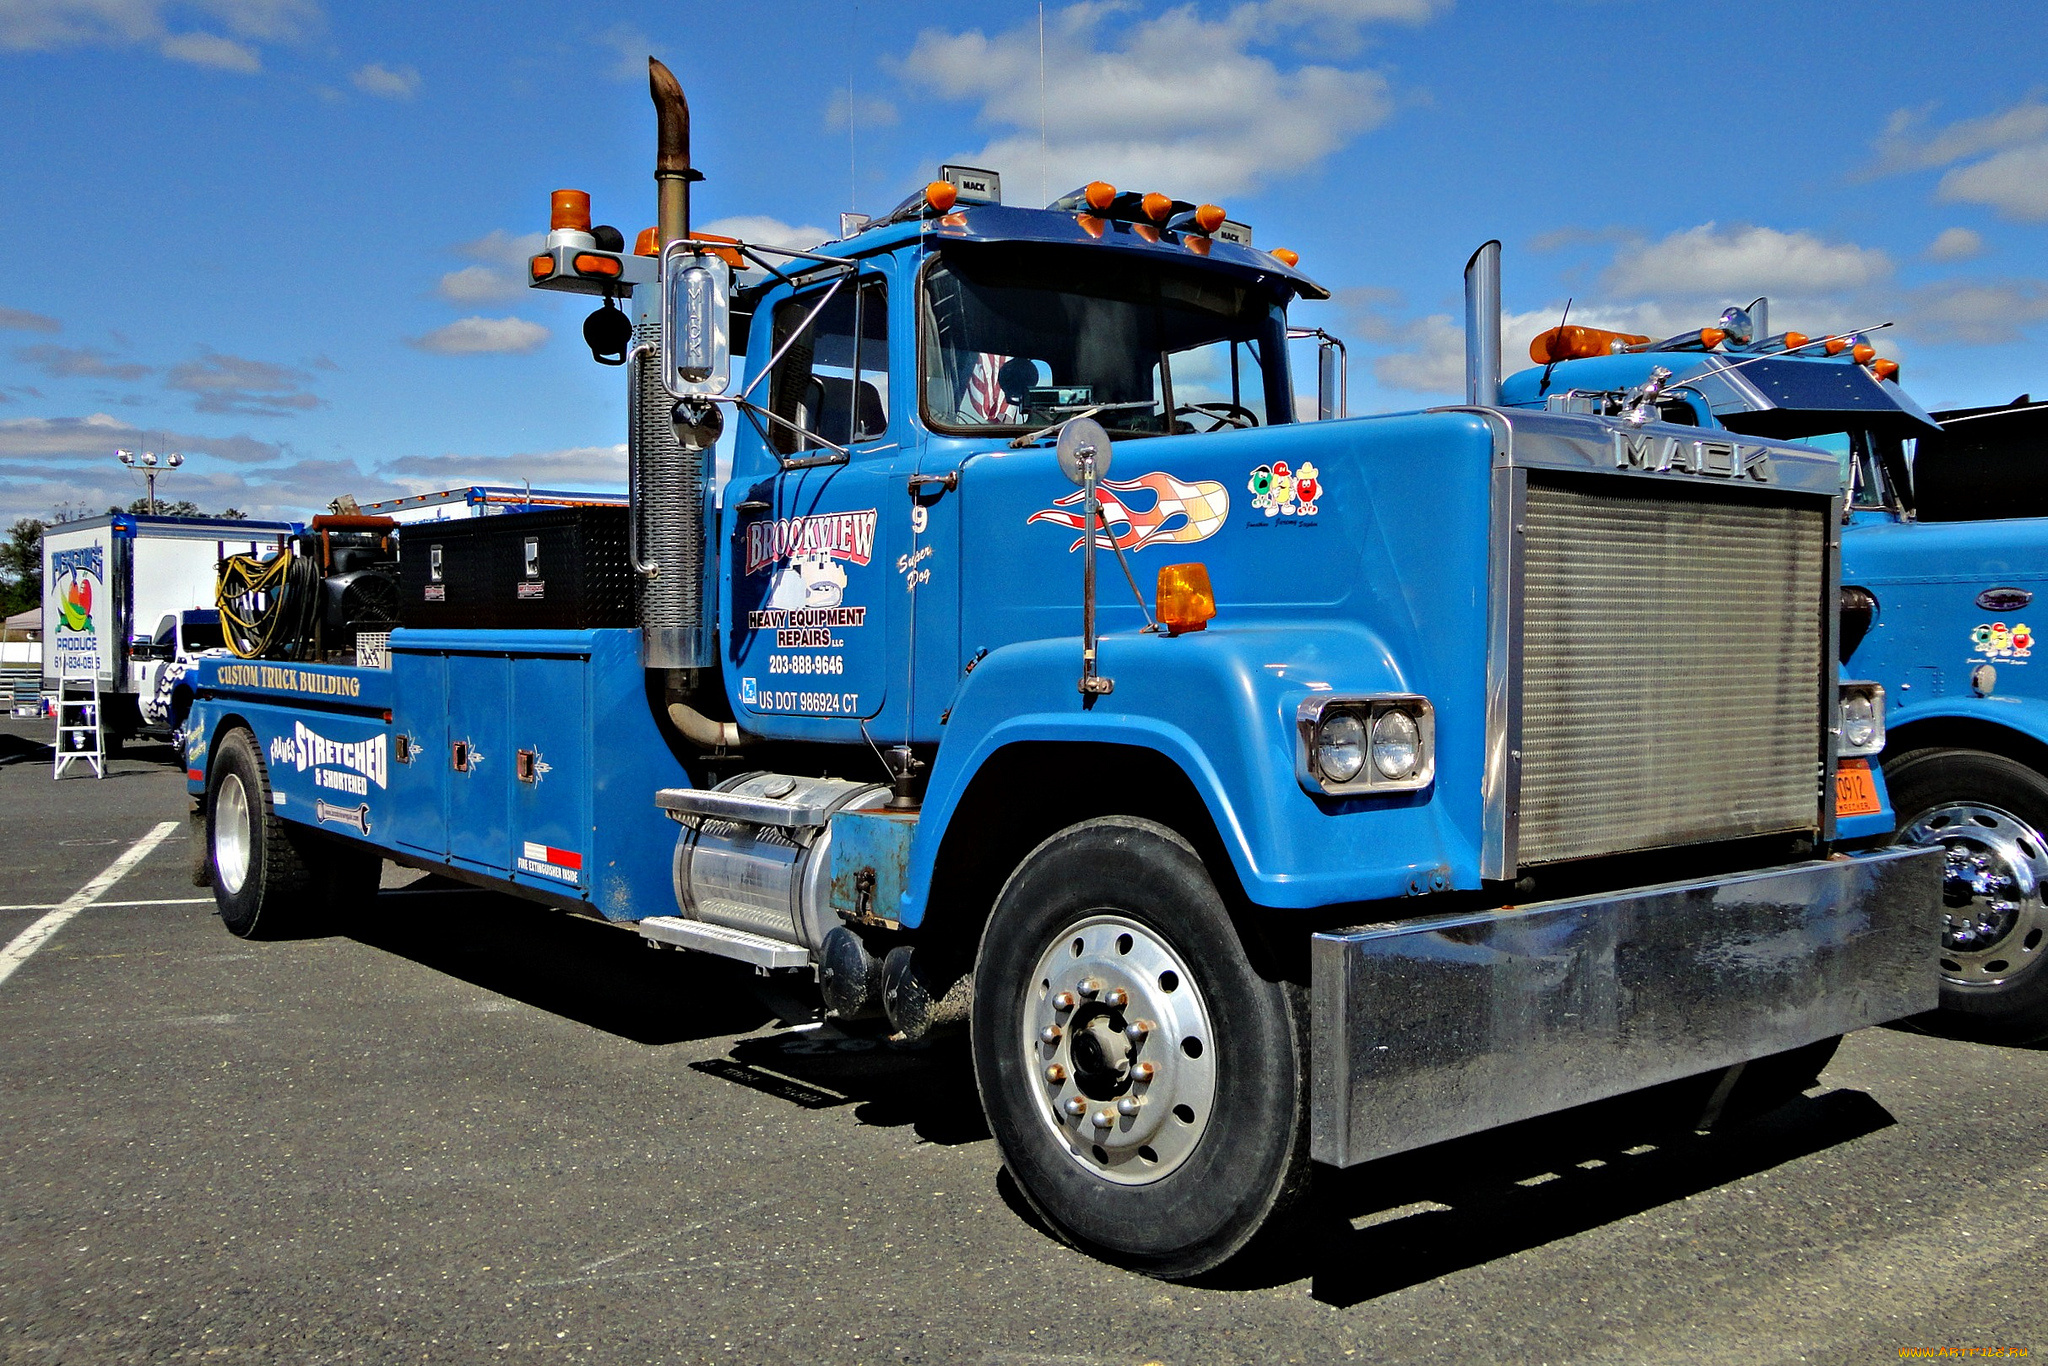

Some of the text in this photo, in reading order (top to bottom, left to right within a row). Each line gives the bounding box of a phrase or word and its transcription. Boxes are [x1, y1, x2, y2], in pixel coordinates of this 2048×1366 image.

[963, 181, 986, 191] MACK
[1614, 430, 1769, 482] MACK
[912, 505, 928, 533] 9
[746, 508, 877, 576] BROOKVIEW
[899, 546, 931, 573] Super
[907, 569, 930, 588] Dog
[749, 608, 865, 629] HEAVY EQUIPMENT
[57, 637, 97, 651] PRODUCE
[778, 630, 844, 647] REPAIRS LLC
[217, 665, 360, 697] CUSTOM TRUCK BUILDING
[760, 691, 773, 708] US
[775, 692, 798, 710] DOT
[800, 693, 840, 711] 986924
[844, 693, 858, 713] CT
[295, 720, 387, 790] STRETCHED
[315, 768, 367, 796] & SHORTENED
[1836, 775, 1866, 801] 0912
